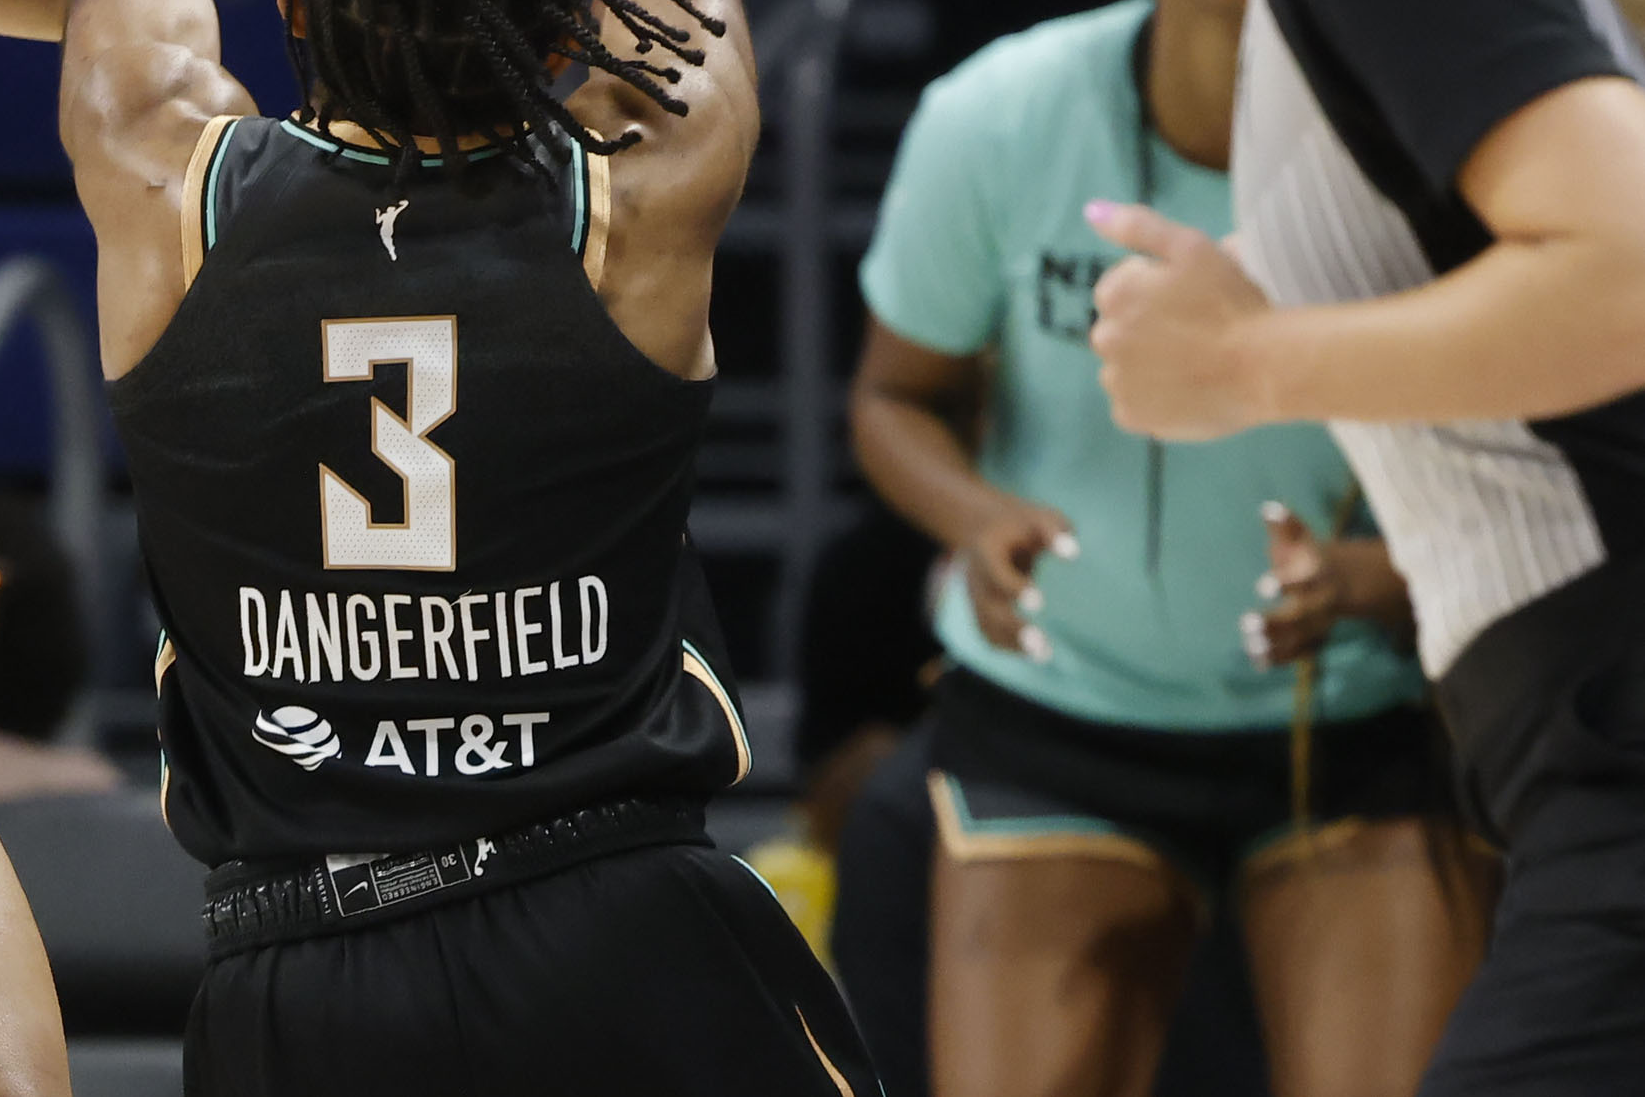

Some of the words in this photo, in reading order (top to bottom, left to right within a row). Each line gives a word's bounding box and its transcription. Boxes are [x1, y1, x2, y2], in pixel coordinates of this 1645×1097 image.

[319, 314, 457, 572] 3
[239, 575, 609, 685] DANGERFIELD
[363, 711, 551, 777] AT&T
[440, 853, 457, 869] 30
